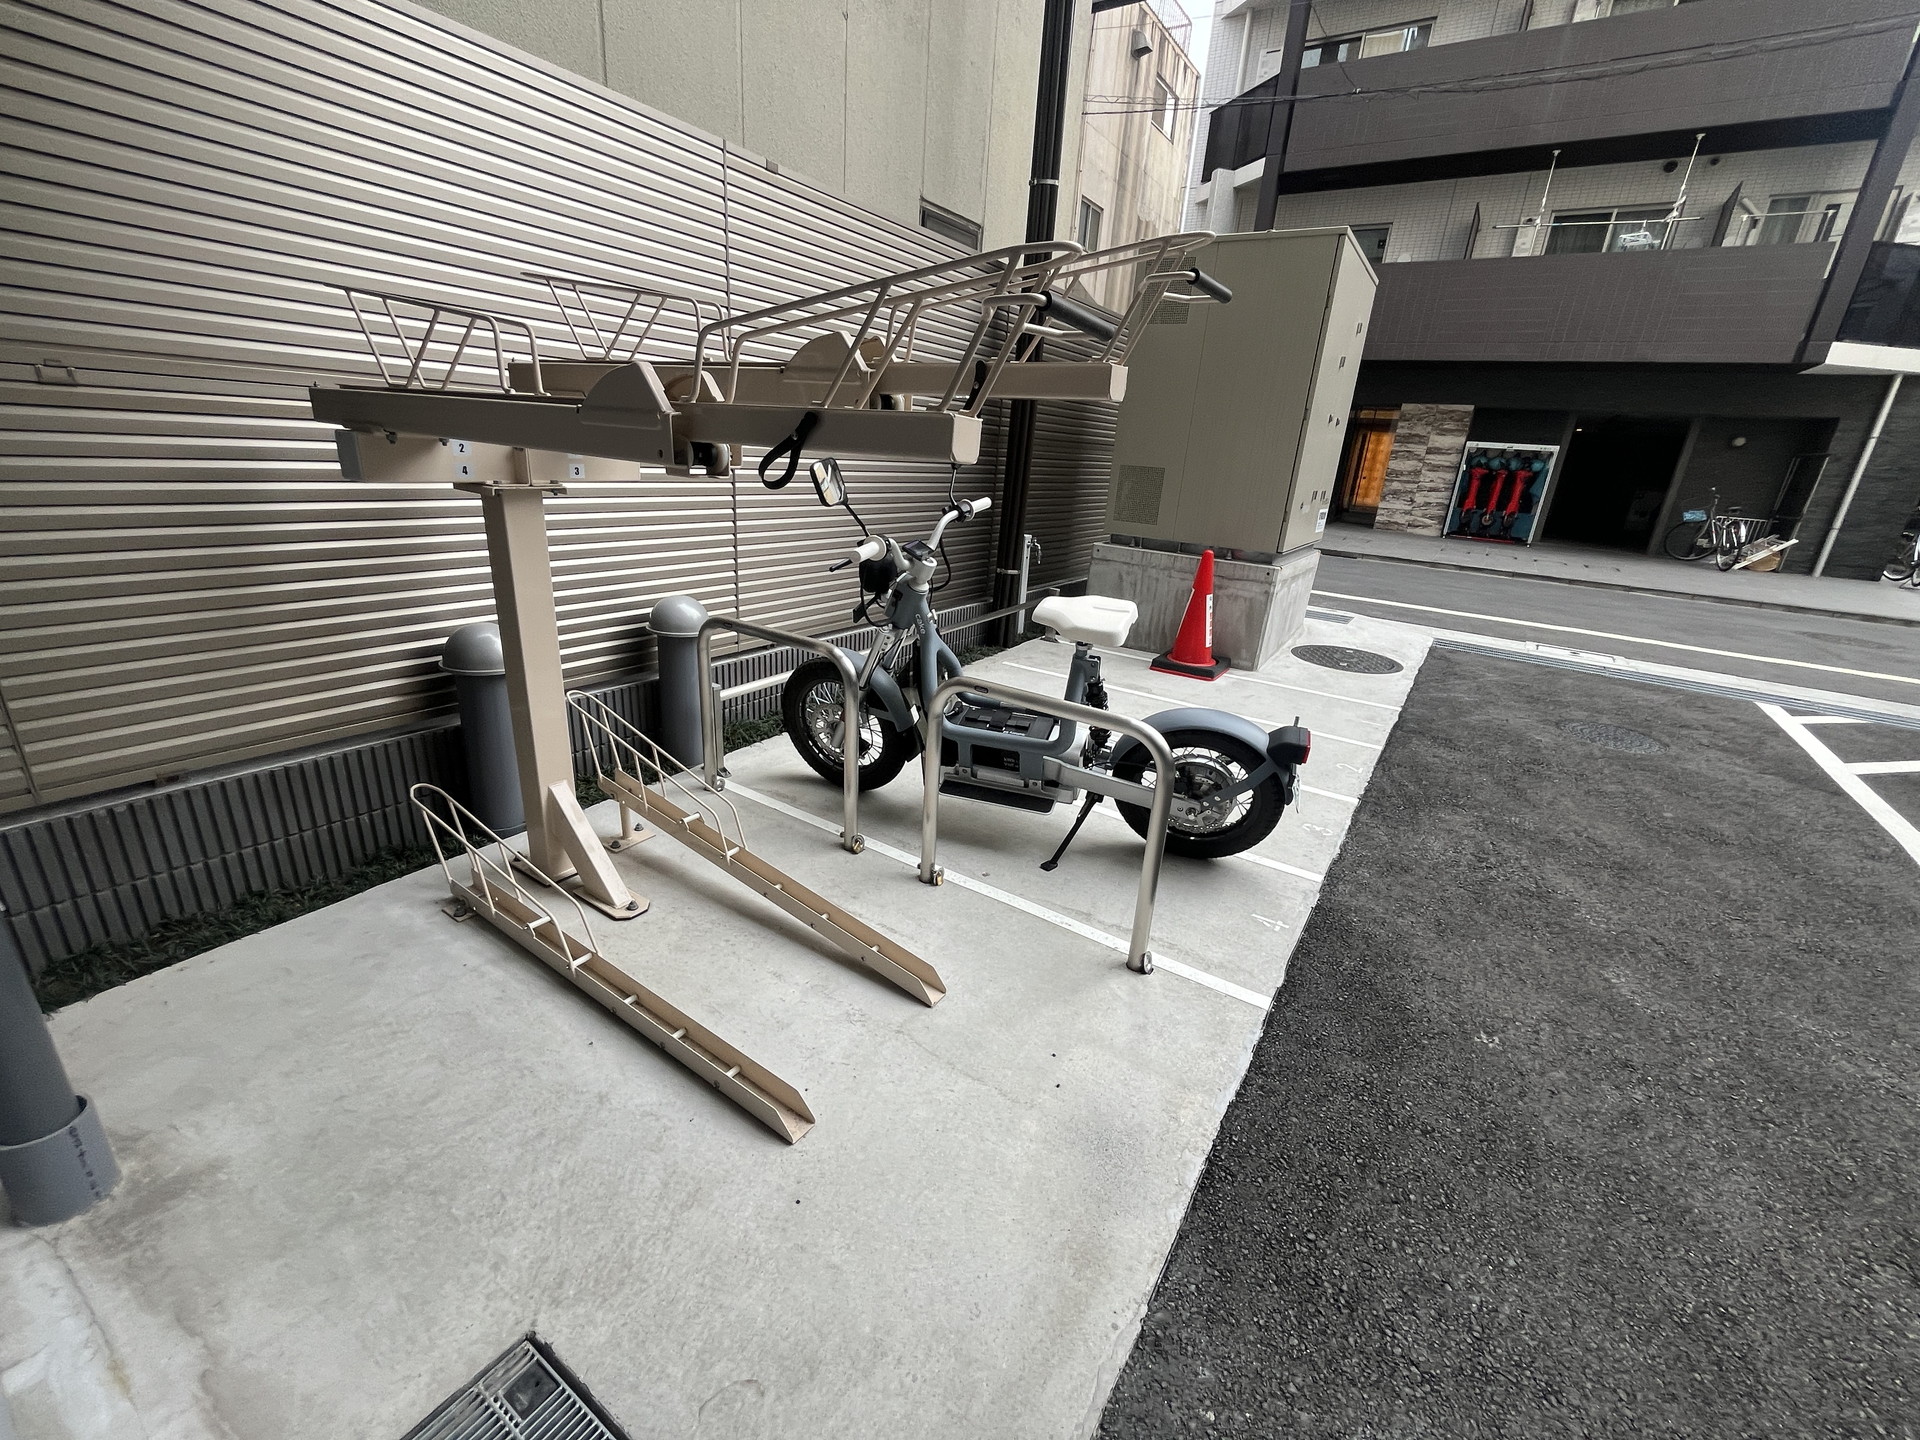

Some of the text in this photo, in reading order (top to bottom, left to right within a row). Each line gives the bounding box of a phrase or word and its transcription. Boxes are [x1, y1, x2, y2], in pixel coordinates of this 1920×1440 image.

[458, 443, 465, 453] 2
[462, 465, 468, 476] 4
[574, 466, 580, 476] 3
[915, 613, 926, 635] cake
[1336, 763, 1363, 774] 2
[1302, 823, 1334, 836] 3
[1251, 913, 1290, 931] 4
